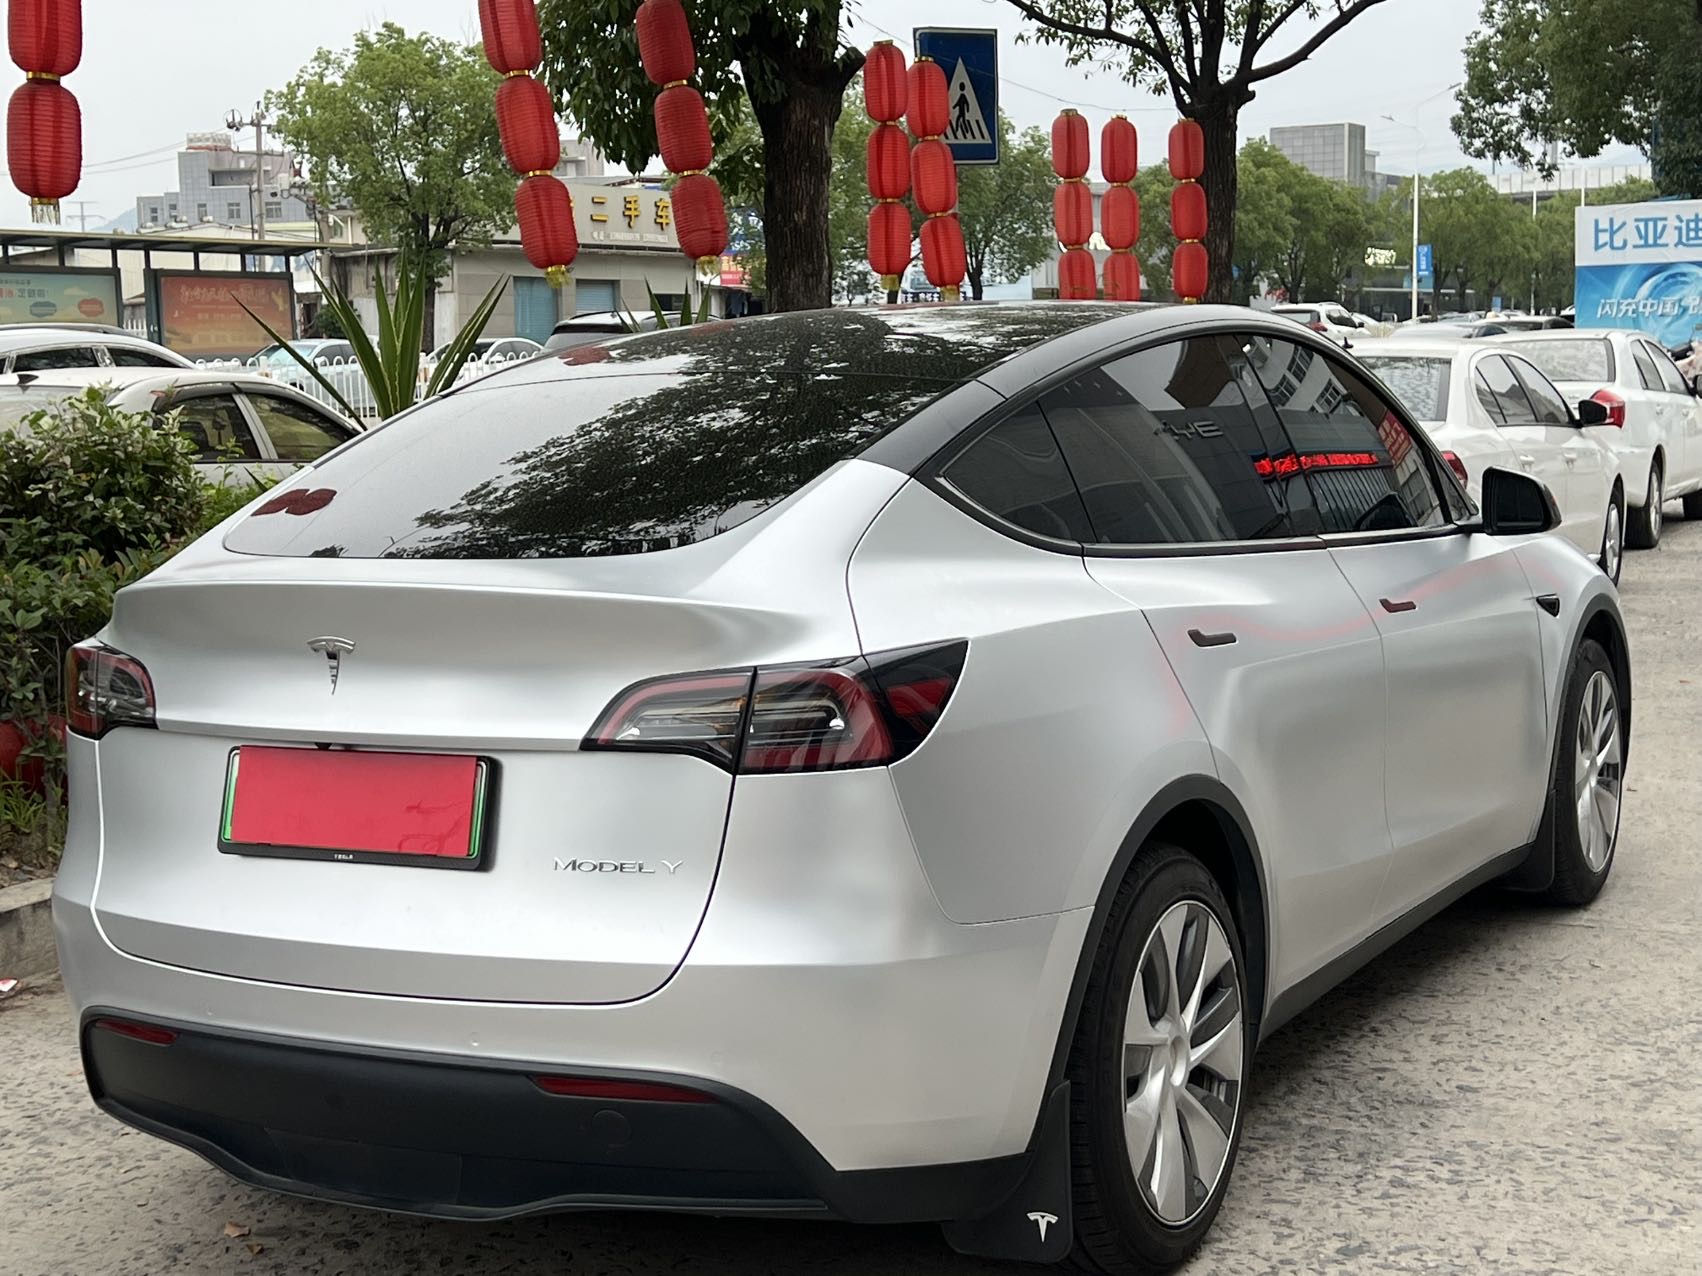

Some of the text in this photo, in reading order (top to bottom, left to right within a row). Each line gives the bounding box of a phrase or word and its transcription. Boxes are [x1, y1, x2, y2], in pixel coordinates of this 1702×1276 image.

[590, 195, 672, 231] 二手车
[1593, 213, 1702, 252] 比亚迪
[553, 857, 683, 873] MODEL Y
